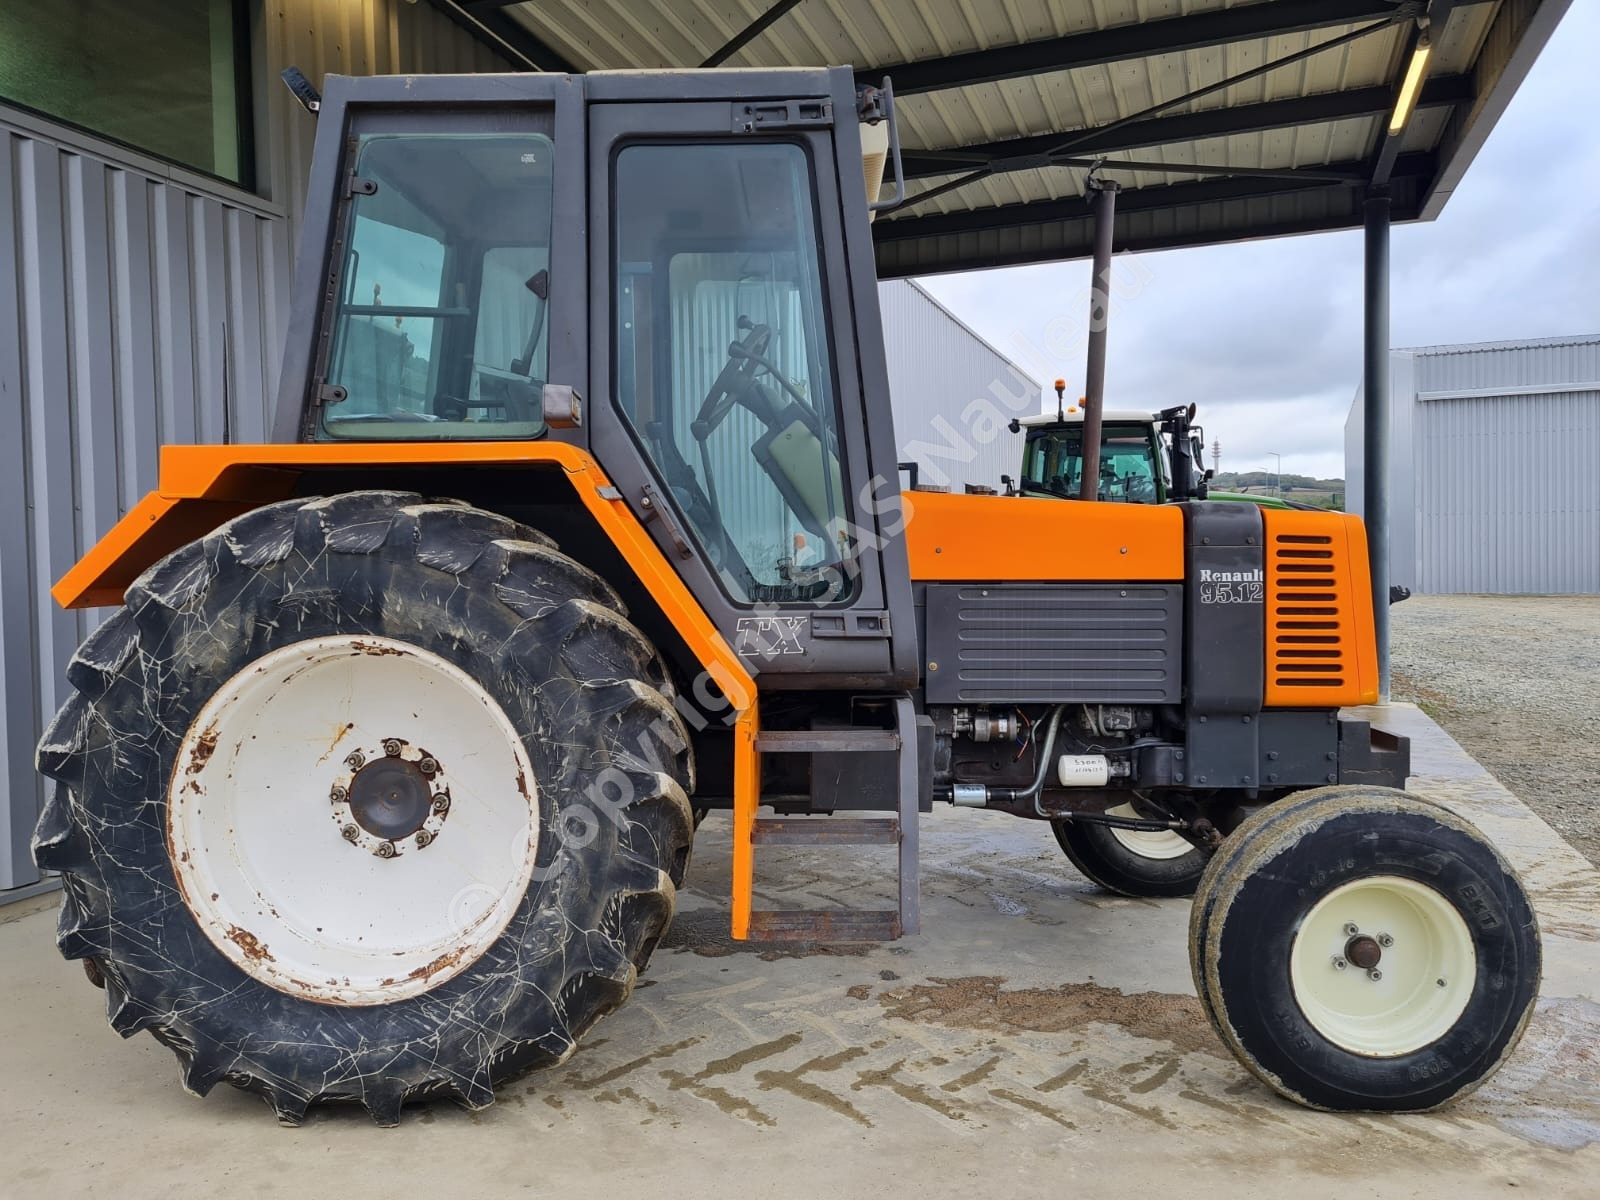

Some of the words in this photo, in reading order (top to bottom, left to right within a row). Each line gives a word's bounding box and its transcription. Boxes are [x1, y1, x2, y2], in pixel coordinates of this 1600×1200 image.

[1199, 568, 1264, 582] Renault
[1200, 582, 1264, 604] 95.12
[736, 616, 808, 656] TX
[1457, 883, 1502, 930] BKT
